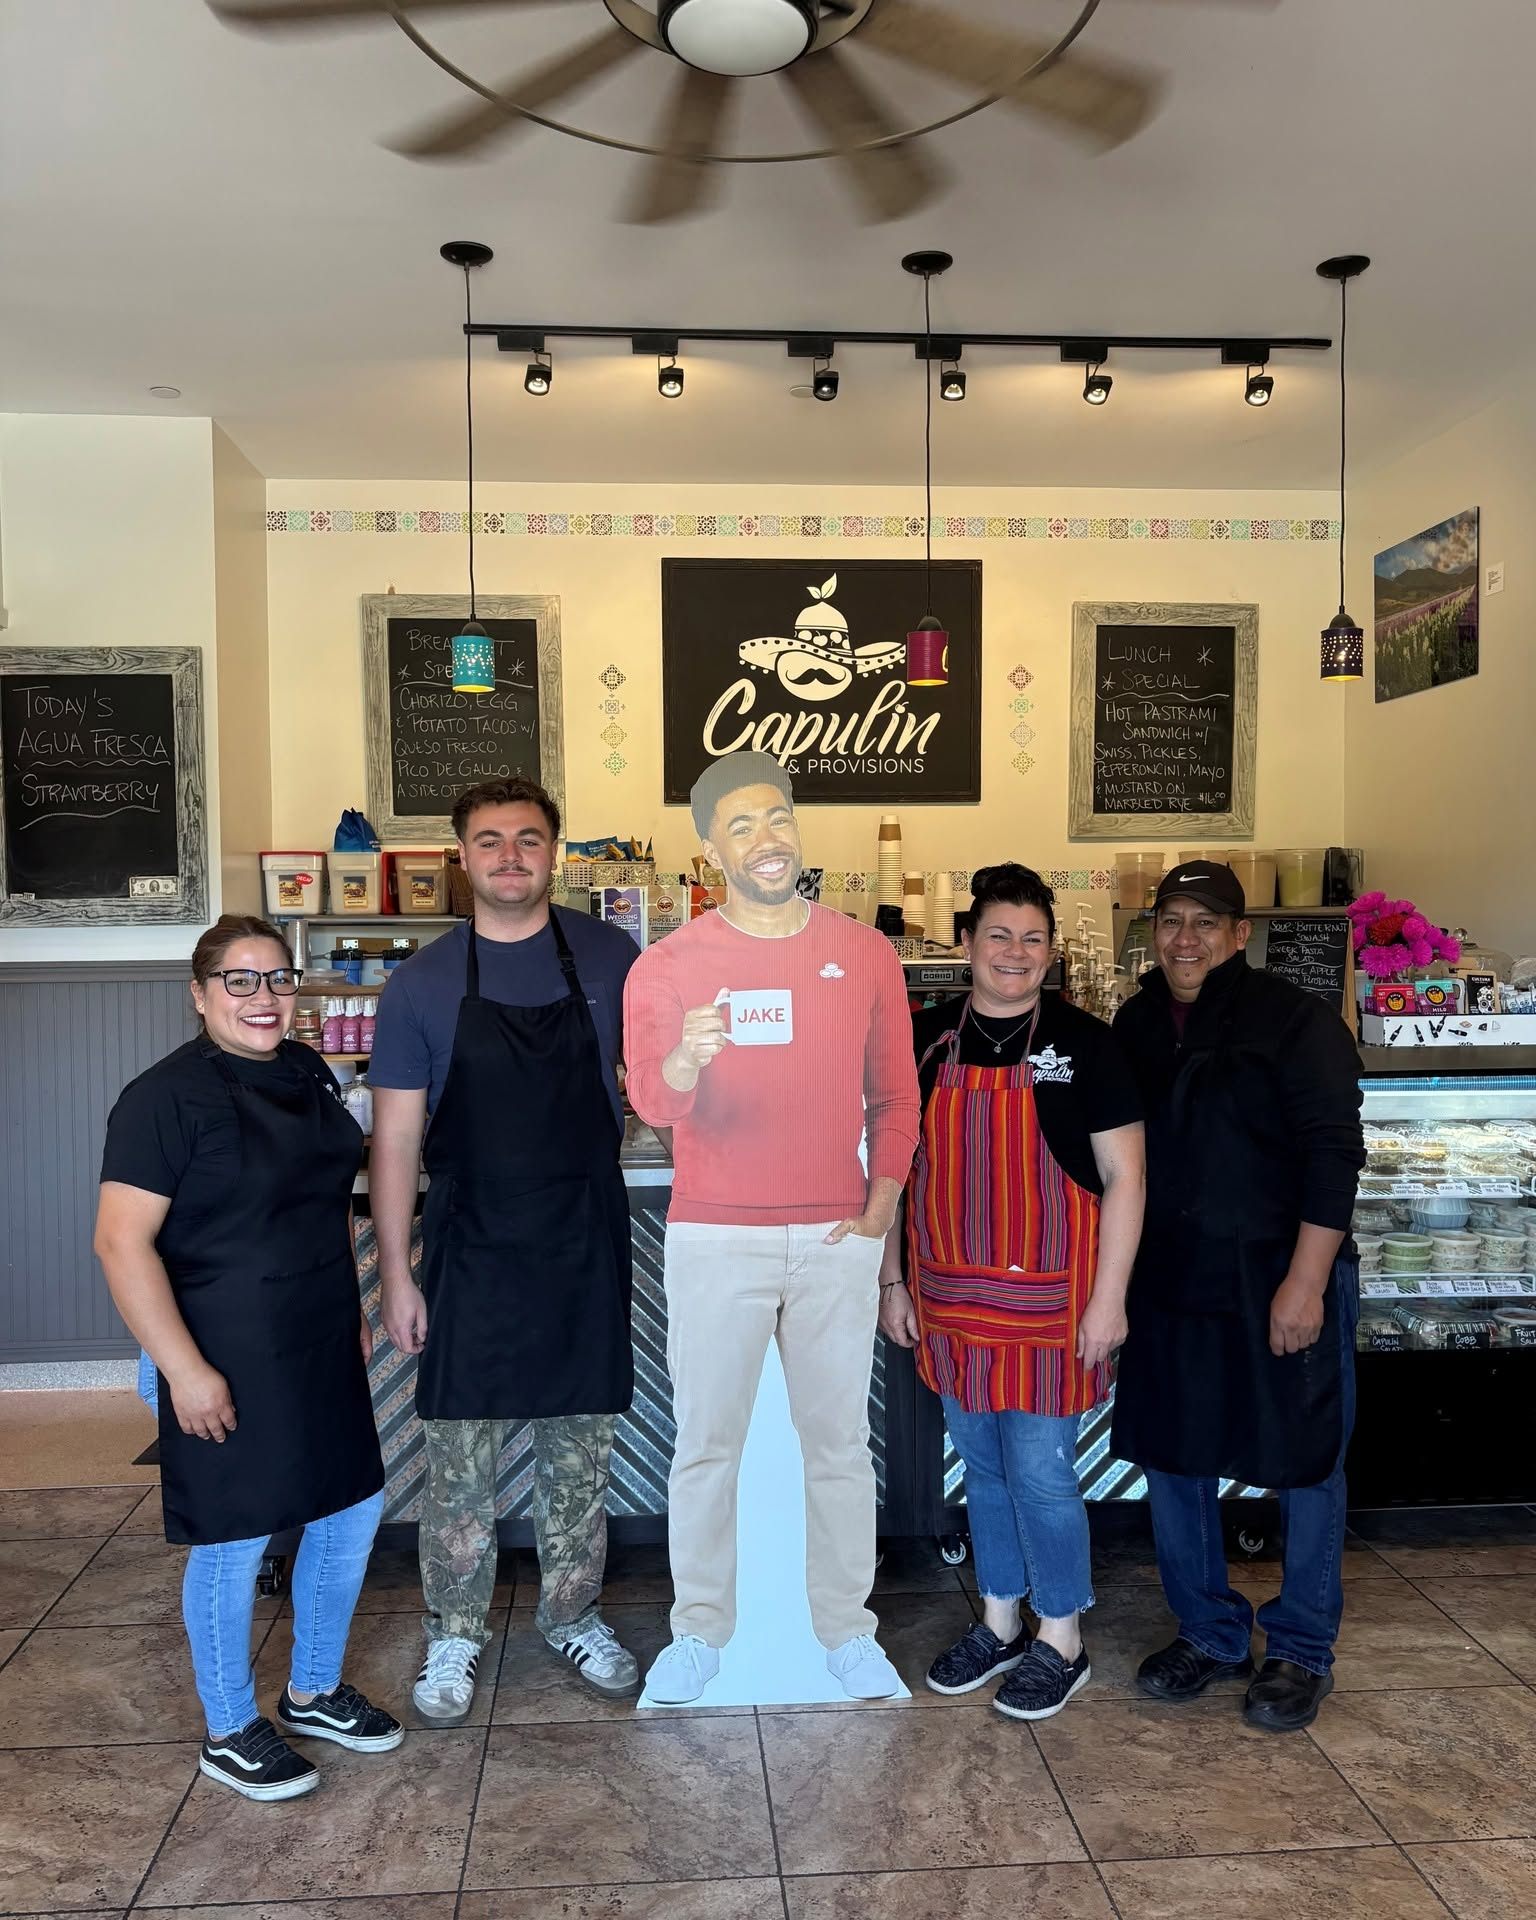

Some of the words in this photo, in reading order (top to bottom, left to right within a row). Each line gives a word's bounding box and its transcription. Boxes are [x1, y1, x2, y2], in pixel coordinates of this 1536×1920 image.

[406, 629, 515, 656] BREAT
[1108, 637, 1171, 663] LUNCH
[1121, 668, 1200, 690] SPECIAL
[12, 686, 114, 725] TODAY'S
[400, 688, 473, 711] CHORIZO,
[476, 693, 518, 711] EGG
[1105, 702, 1134, 722] HOT
[1138, 701, 1216, 721] PASTRAMI
[407, 713, 467, 734] POTATO
[469, 715, 517, 735] TACOS
[703, 678, 941, 768] Capulin
[1122, 722, 1190, 740] SANDWICH
[18, 728, 84, 757] AGUA
[90, 728, 169, 758] FRESCA
[394, 737, 441, 756] QUESO
[396, 760, 429, 778] PICO
[432, 761, 456, 777] DE
[458, 759, 510, 777] GALLO
[787, 758, 800, 774] &
[808, 758, 924, 774] PROVISIONS
[1189, 764, 1225, 782] MAYO
[22, 773, 160, 808] STRAWBERRY
[397, 783, 406, 799] A
[409, 783, 438, 798] SIDE
[440, 783, 463, 798] OF
[1104, 781, 1163, 796] MUSTARD
[1166, 782, 1186, 795] ON
[1104, 797, 1163, 811] MARBLED
[1167, 797, 1193, 812] RYE
[1295, 921, 1348, 932] BUTTERNUT
[1295, 933, 1330, 942] SQUASH
[1268, 945, 1298, 954] GREEK
[1299, 945, 1324, 955] PASTA
[1286, 953, 1315, 963] SALAD
[1310, 966, 1337, 976] APPLE
[1302, 975, 1338, 987] PUDDING
[737, 1008, 785, 1024] JAKE
[1032, 1064, 1074, 1084] apulin
[1372, 1334, 1399, 1346] CAPULIN
[1455, 1334, 1477, 1346] COBB
[1514, 1328, 1536, 1338] FRUIT
